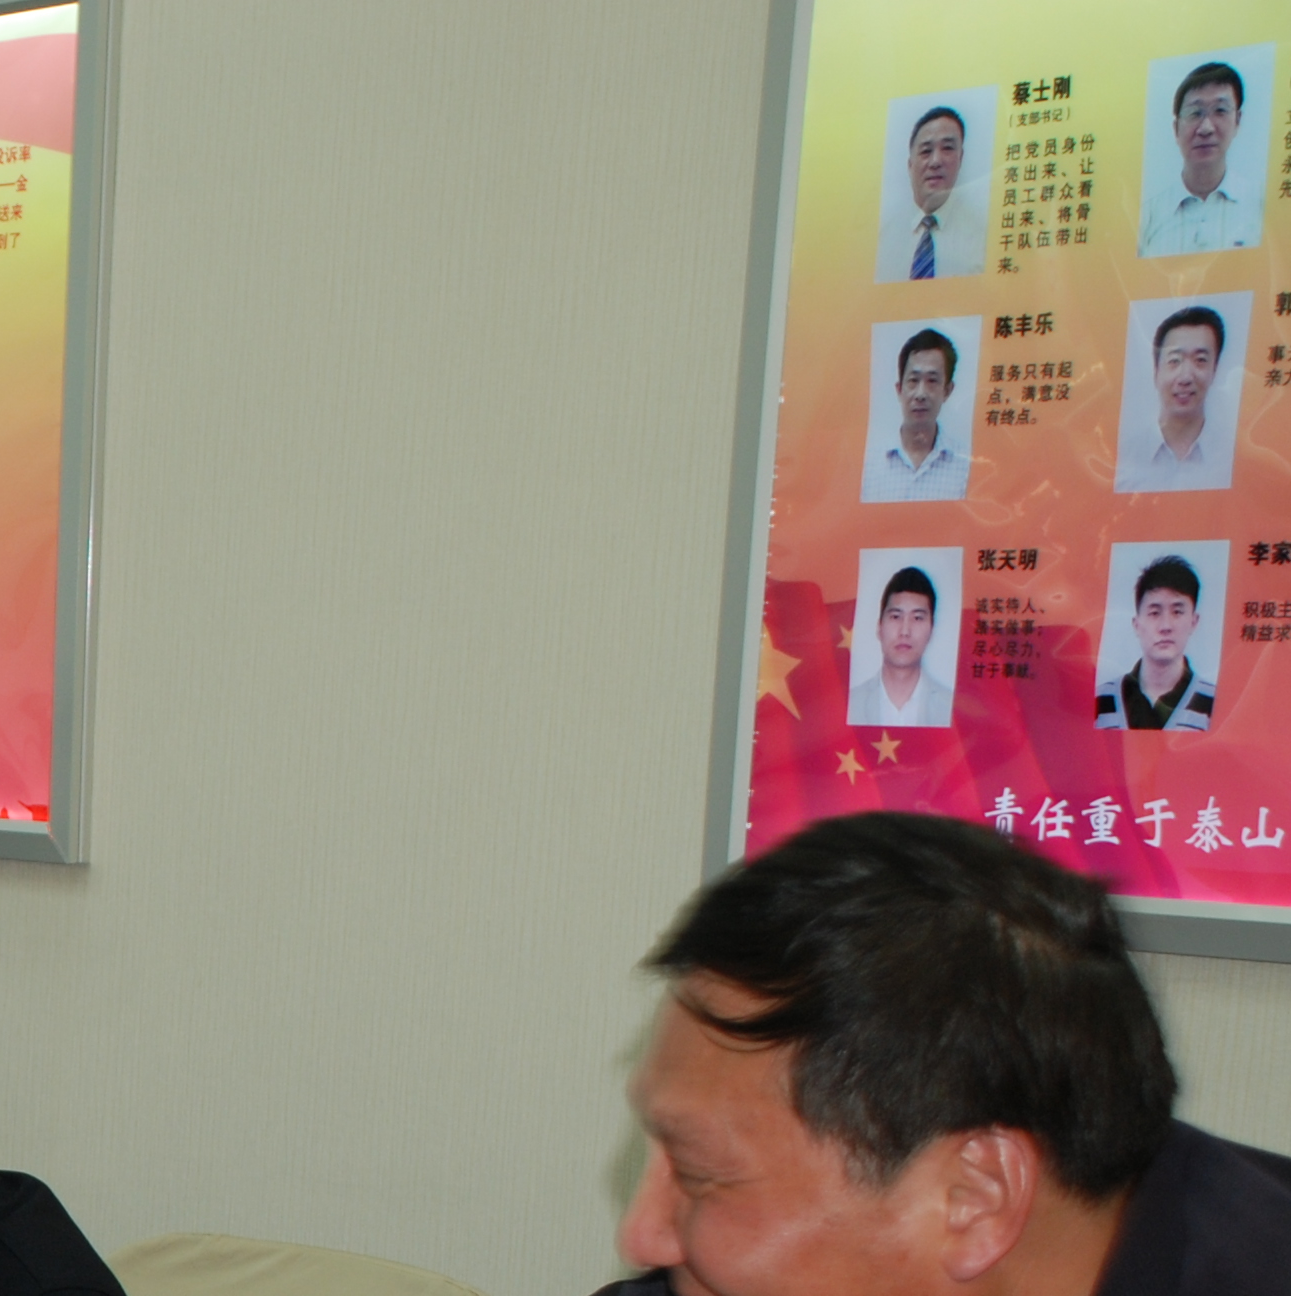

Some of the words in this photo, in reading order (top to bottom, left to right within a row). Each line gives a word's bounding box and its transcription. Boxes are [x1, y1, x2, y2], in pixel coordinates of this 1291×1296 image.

[1011, 75, 1072, 106] 蔡士刚
[1005, 133, 1096, 161] 把党员身份
[1003, 157, 1095, 184] 亮出来、让
[1002, 180, 1093, 207] 员工群众看
[1000, 203, 1091, 230] 出来、将骨
[999, 226, 1090, 251] 干队伍带出
[997, 257, 1021, 274] 来。
[993, 313, 1054, 338] 陈丰乐
[988, 360, 1074, 383] 服务只有起
[986, 383, 1071, 406] 点，满意没
[985, 407, 1039, 427] 有终点。
[977, 548, 1038, 571] 张天明
[975, 597, 1046, 615] 诚实待人、
[984, 786, 1287, 852] 责任重于泰山
